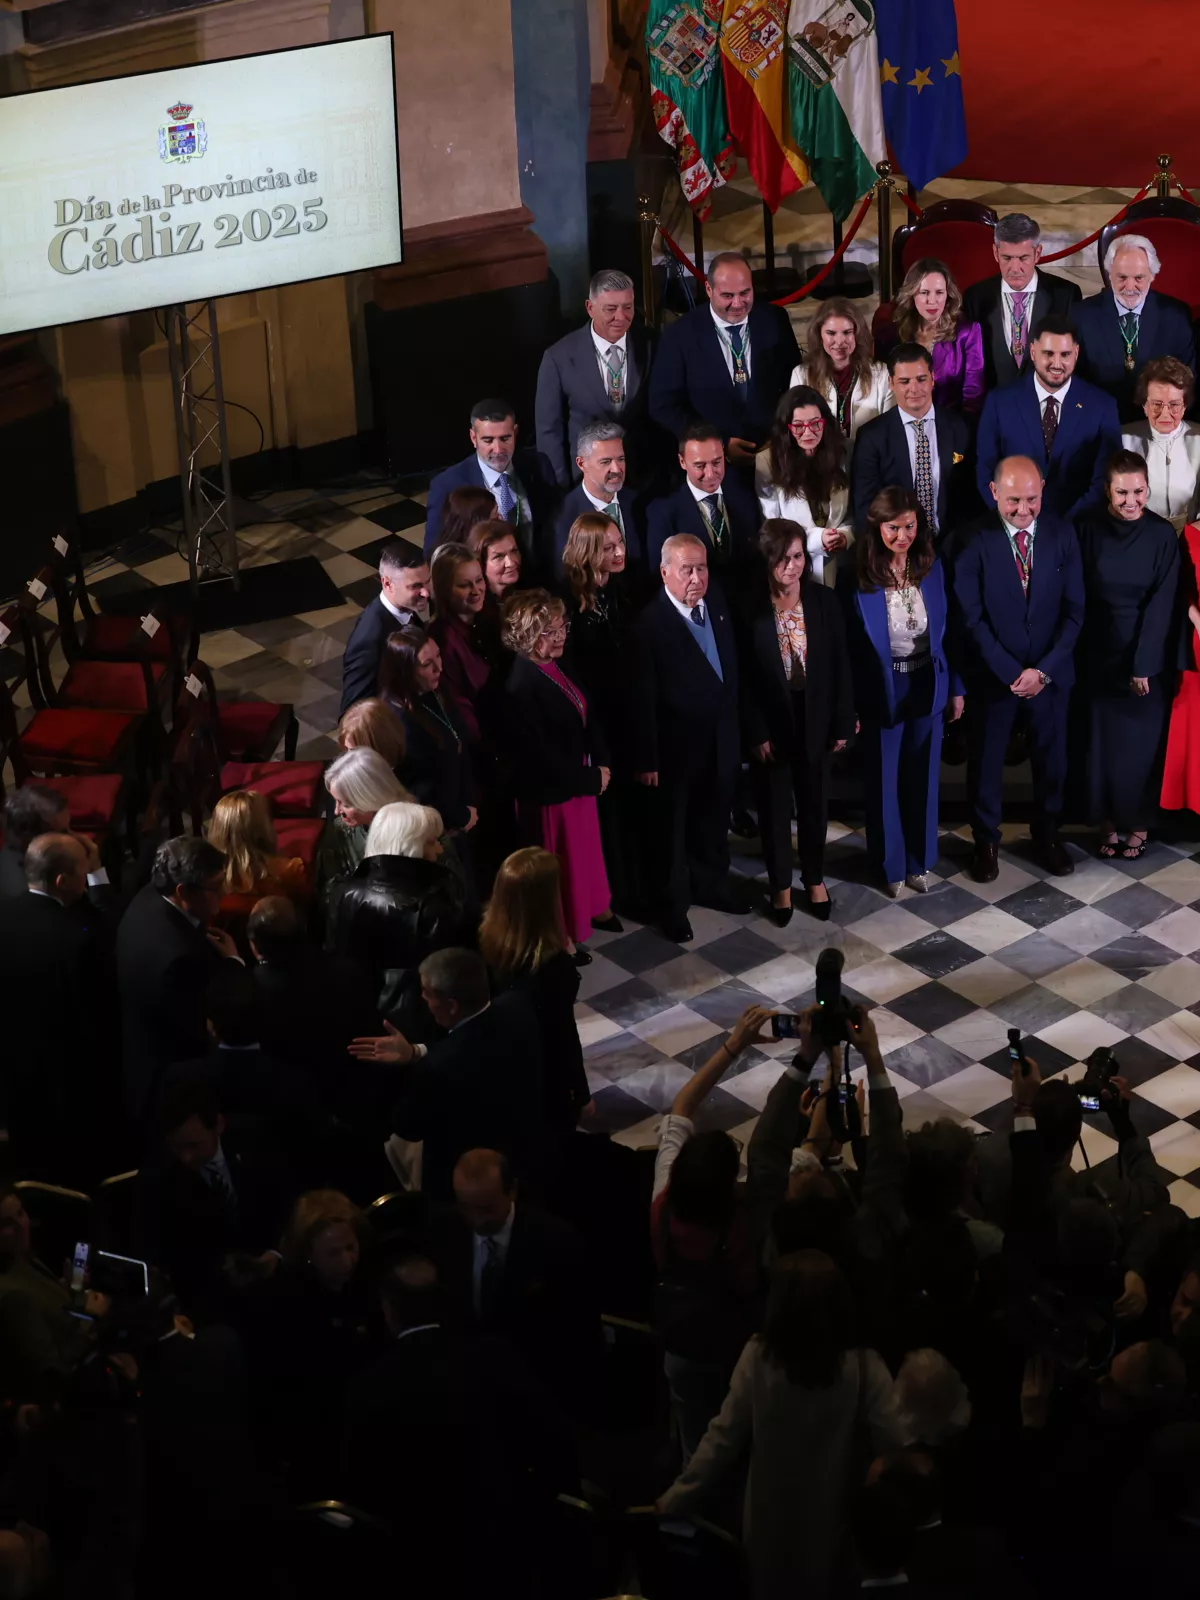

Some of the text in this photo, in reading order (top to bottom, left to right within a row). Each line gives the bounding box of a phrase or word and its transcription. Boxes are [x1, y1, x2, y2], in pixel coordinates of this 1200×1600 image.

[54, 168, 317, 227] Día de la Provincia de
[48, 197, 328, 275] Cádiz 2025
